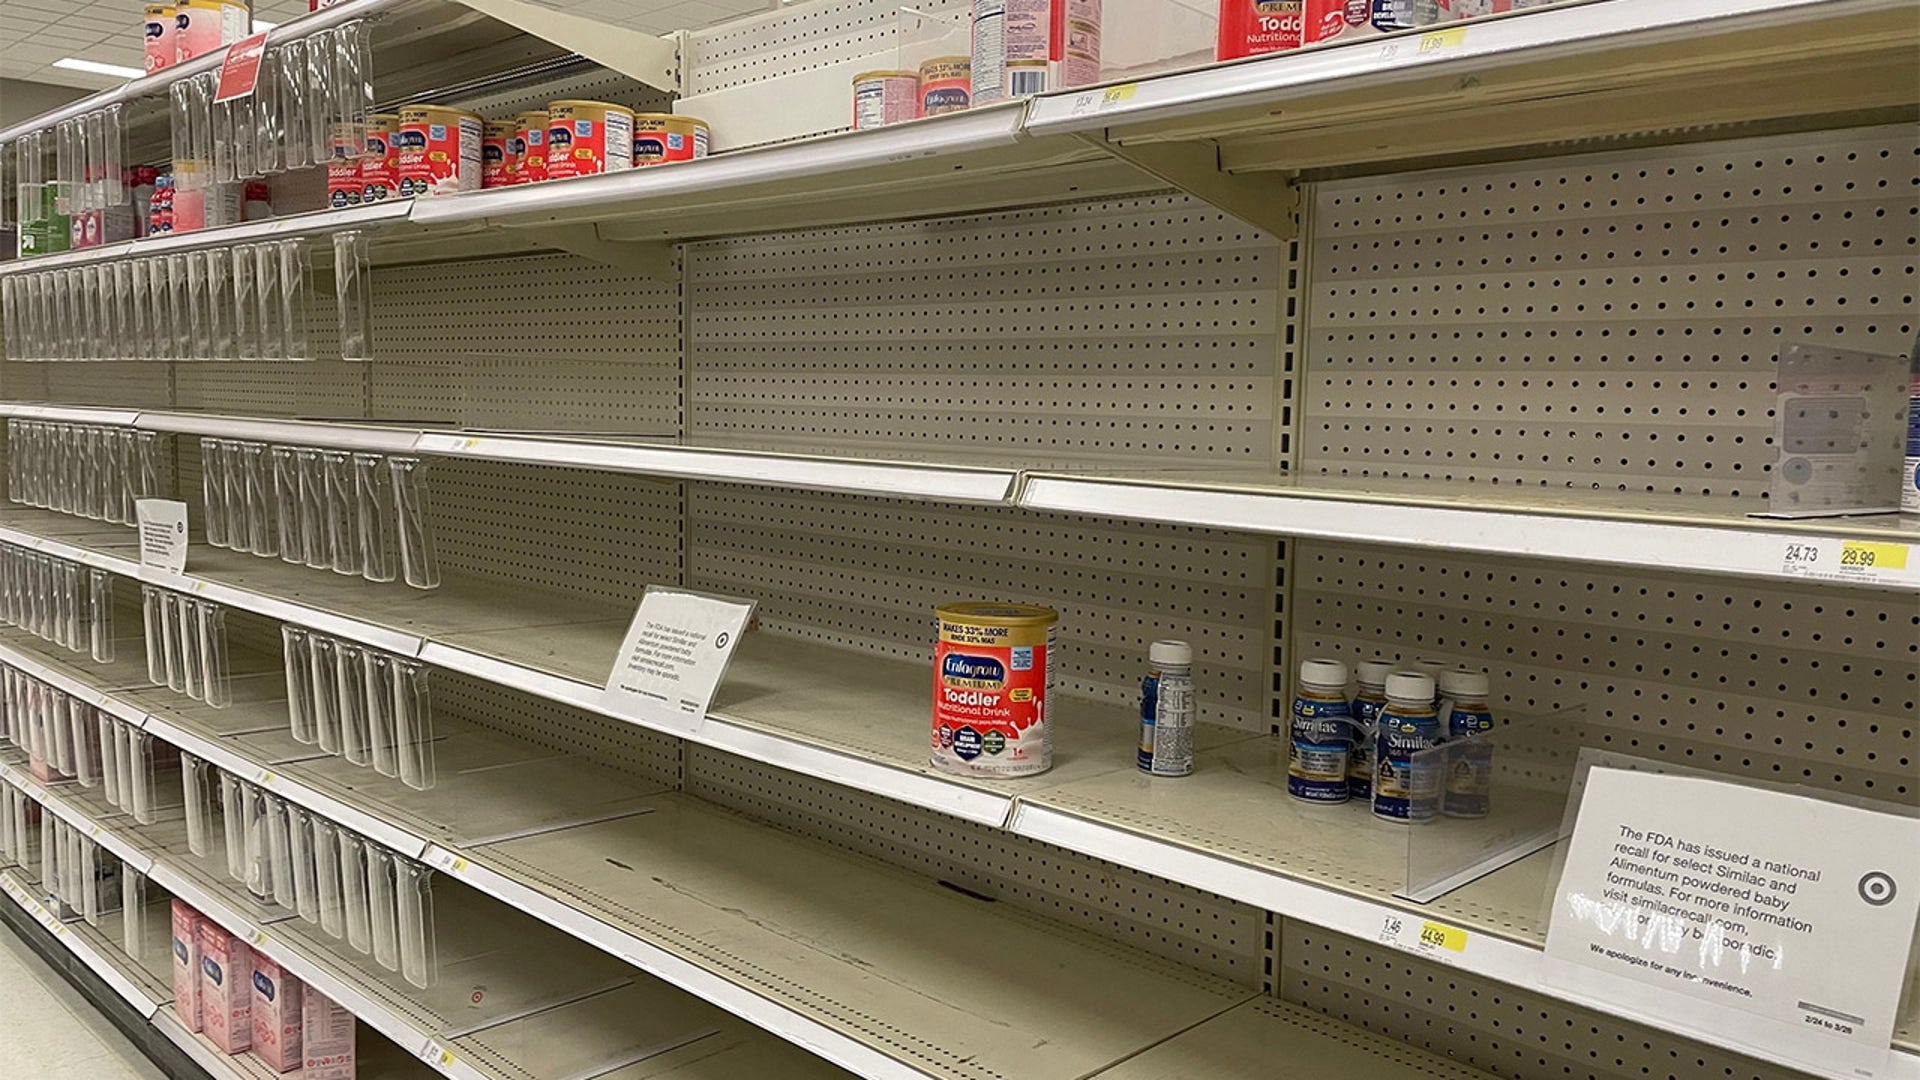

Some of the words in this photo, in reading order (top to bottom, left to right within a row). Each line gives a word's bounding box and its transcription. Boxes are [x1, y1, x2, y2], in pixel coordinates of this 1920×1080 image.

[1258, 16, 1301, 31] Todd
[1246, 32, 1301, 43] Nutritiona
[1785, 545, 1818, 562] 24.73
[1841, 550, 1875, 566] 29.99
[946, 657, 1001, 677] Enfagrow
[943, 688, 1001, 707] Toddler
[983, 707, 1010, 717] Drink
[1619, 825, 1643, 840] The
[1646, 832, 1673, 848] FDA
[1677, 839, 1701, 854] has
[1704, 845, 1749, 865] issued
[1752, 858, 1761, 868] a
[1764, 861, 1821, 882] national
[1614, 843, 1650, 859] recall
[1652, 850, 1671, 863] for
[1672, 857, 1713, 874] select
[1716, 865, 1766, 887] Similac
[1769, 879, 1797, 894] and
[1610, 857, 1679, 881] Alimentum
[1681, 876, 1751, 900] powdered
[1754, 891, 1790, 912] baby
[1603, 888, 1628, 903] visit
[1607, 871, 1665, 896] formulas.
[1669, 887, 1692, 902] For
[1694, 896, 1730, 912] more
[1733, 903, 1813, 934] information
[1590, 943, 1604, 954] We
[1606, 949, 1649, 967] apologize
[1650, 961, 1663, 972] for
[1665, 967, 1682, 978] any
